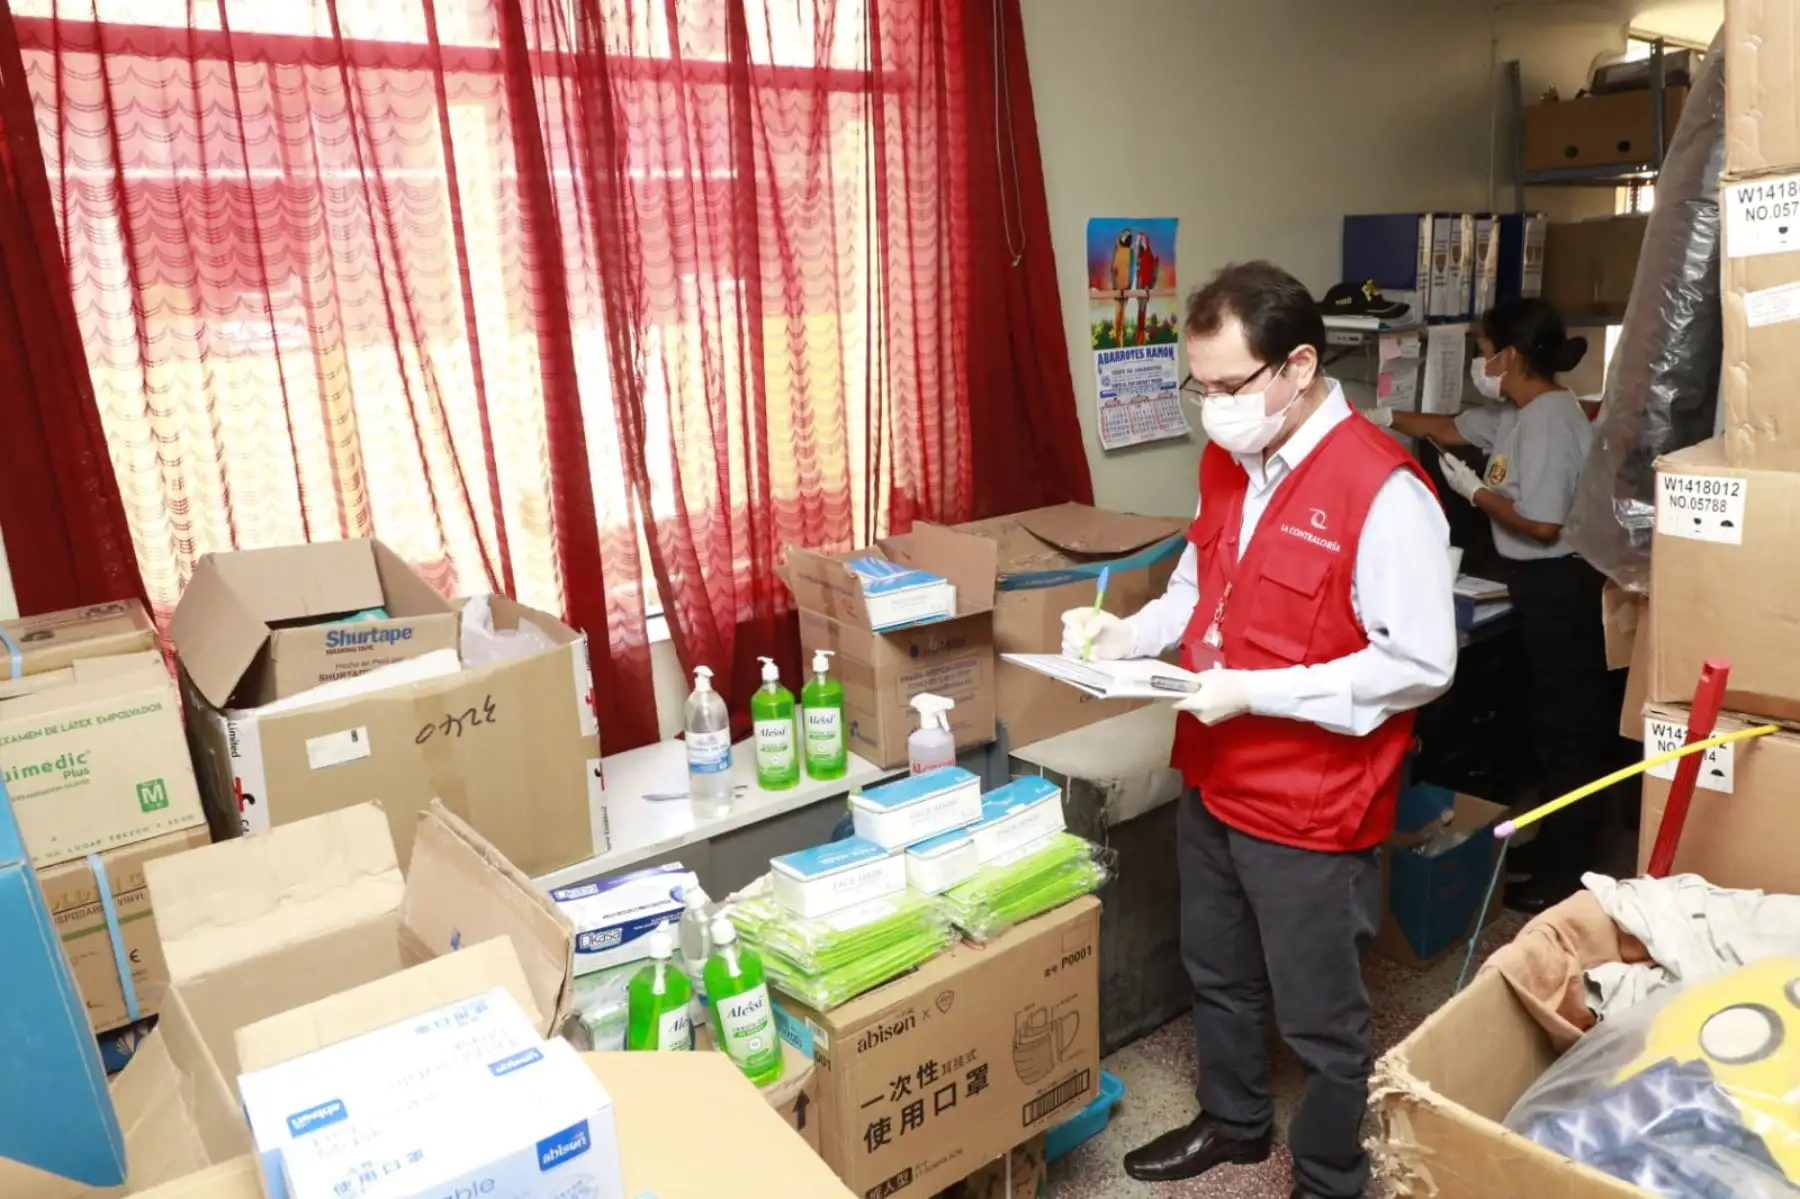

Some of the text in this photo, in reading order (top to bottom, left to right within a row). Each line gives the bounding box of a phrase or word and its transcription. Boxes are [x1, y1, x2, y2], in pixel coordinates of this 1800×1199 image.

[1737, 181, 1800, 204] W1418
[1098, 349, 1144, 364] ABARROTES
[1664, 477, 1740, 497] W1418012
[1669, 495, 1727, 513] NO.05788
[325, 627, 413, 647] Shurtape
[325, 644, 374, 655] MASKING TAPE
[44, 724, 57, 736] DE
[61, 716, 92, 732] LÁTEX
[96, 702, 163, 725] EMPOLVADOS
[228, 721, 241, 758] Limited
[2, 751, 88, 783] uimedic
[63, 767, 90, 780] Plus
[143, 786, 163, 804] M
[1062, 946, 1092, 969] P0001
[857, 1014, 916, 1053] abison
[861, 1059, 939, 1109] 一次性
[863, 1063, 989, 1154] 使用口罩
